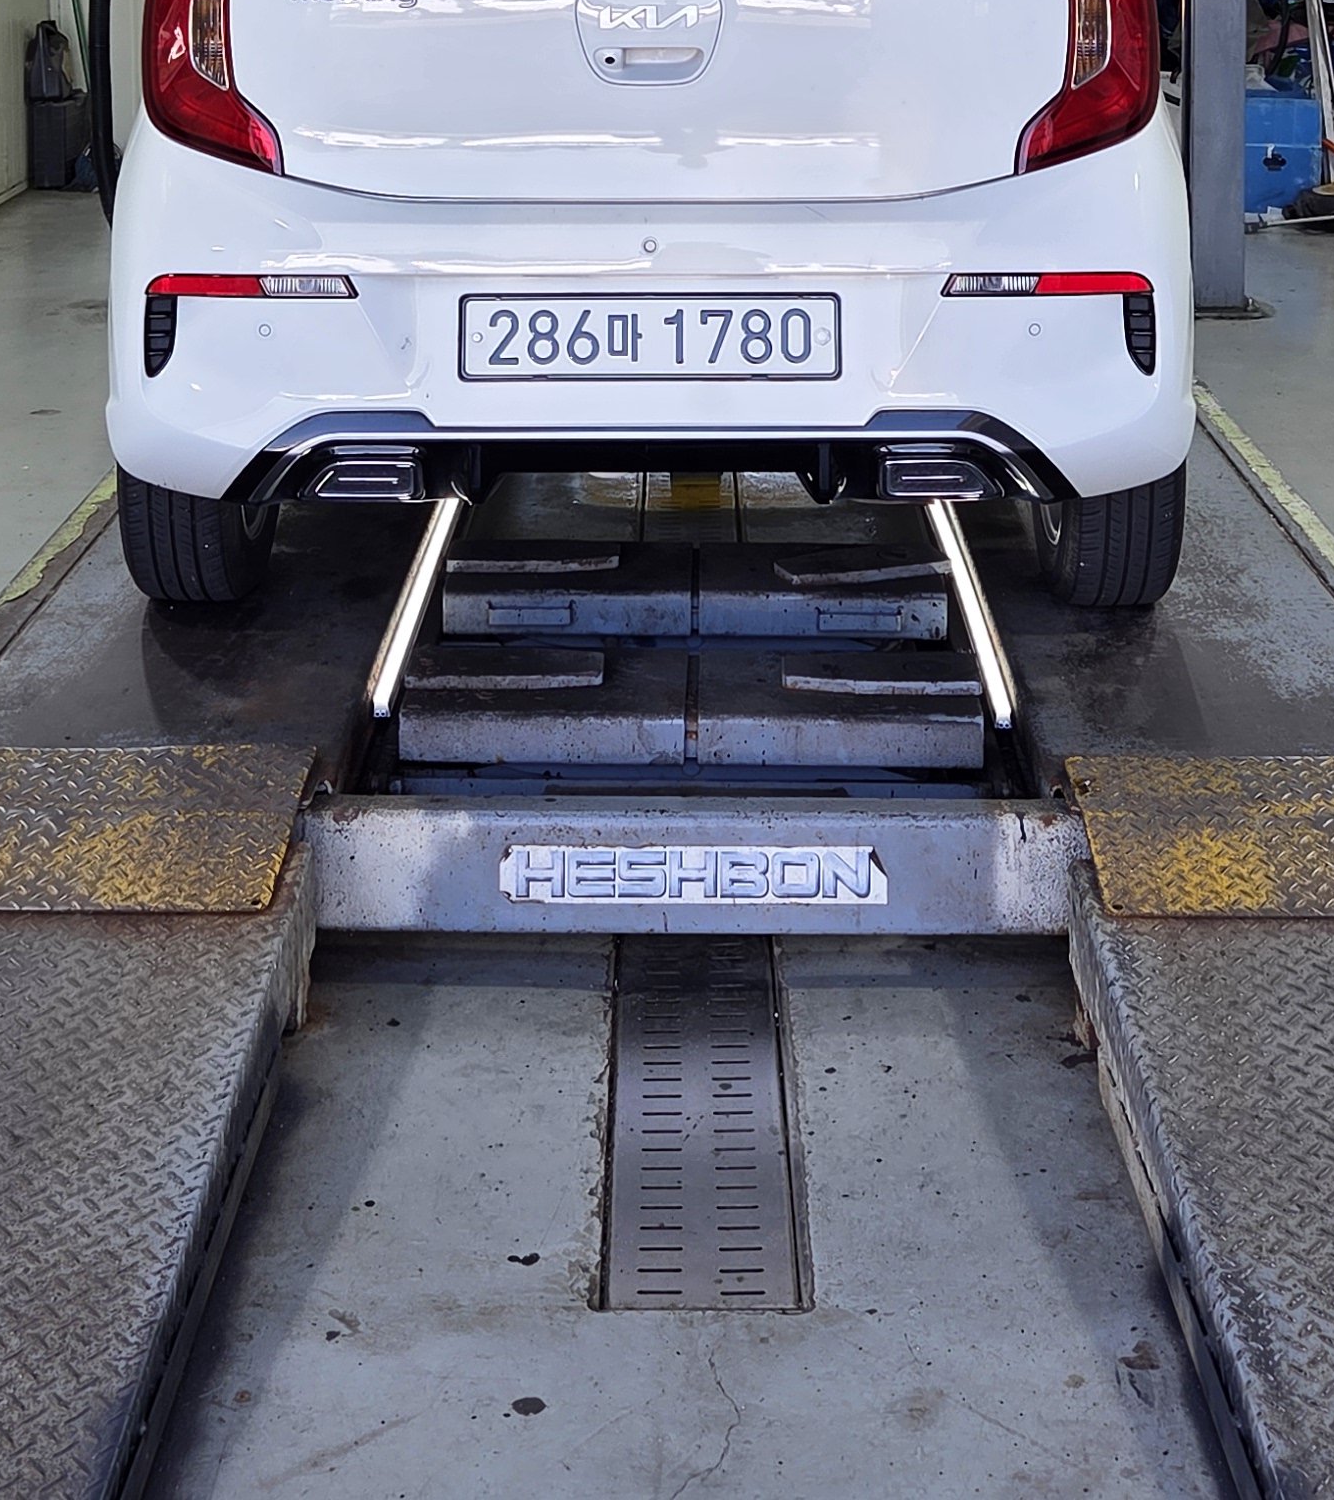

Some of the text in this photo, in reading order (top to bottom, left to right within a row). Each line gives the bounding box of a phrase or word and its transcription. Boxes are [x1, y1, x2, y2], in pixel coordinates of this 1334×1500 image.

[488, 308, 812, 366] 286마 1780
[516, 850, 870, 898] HESHBON
